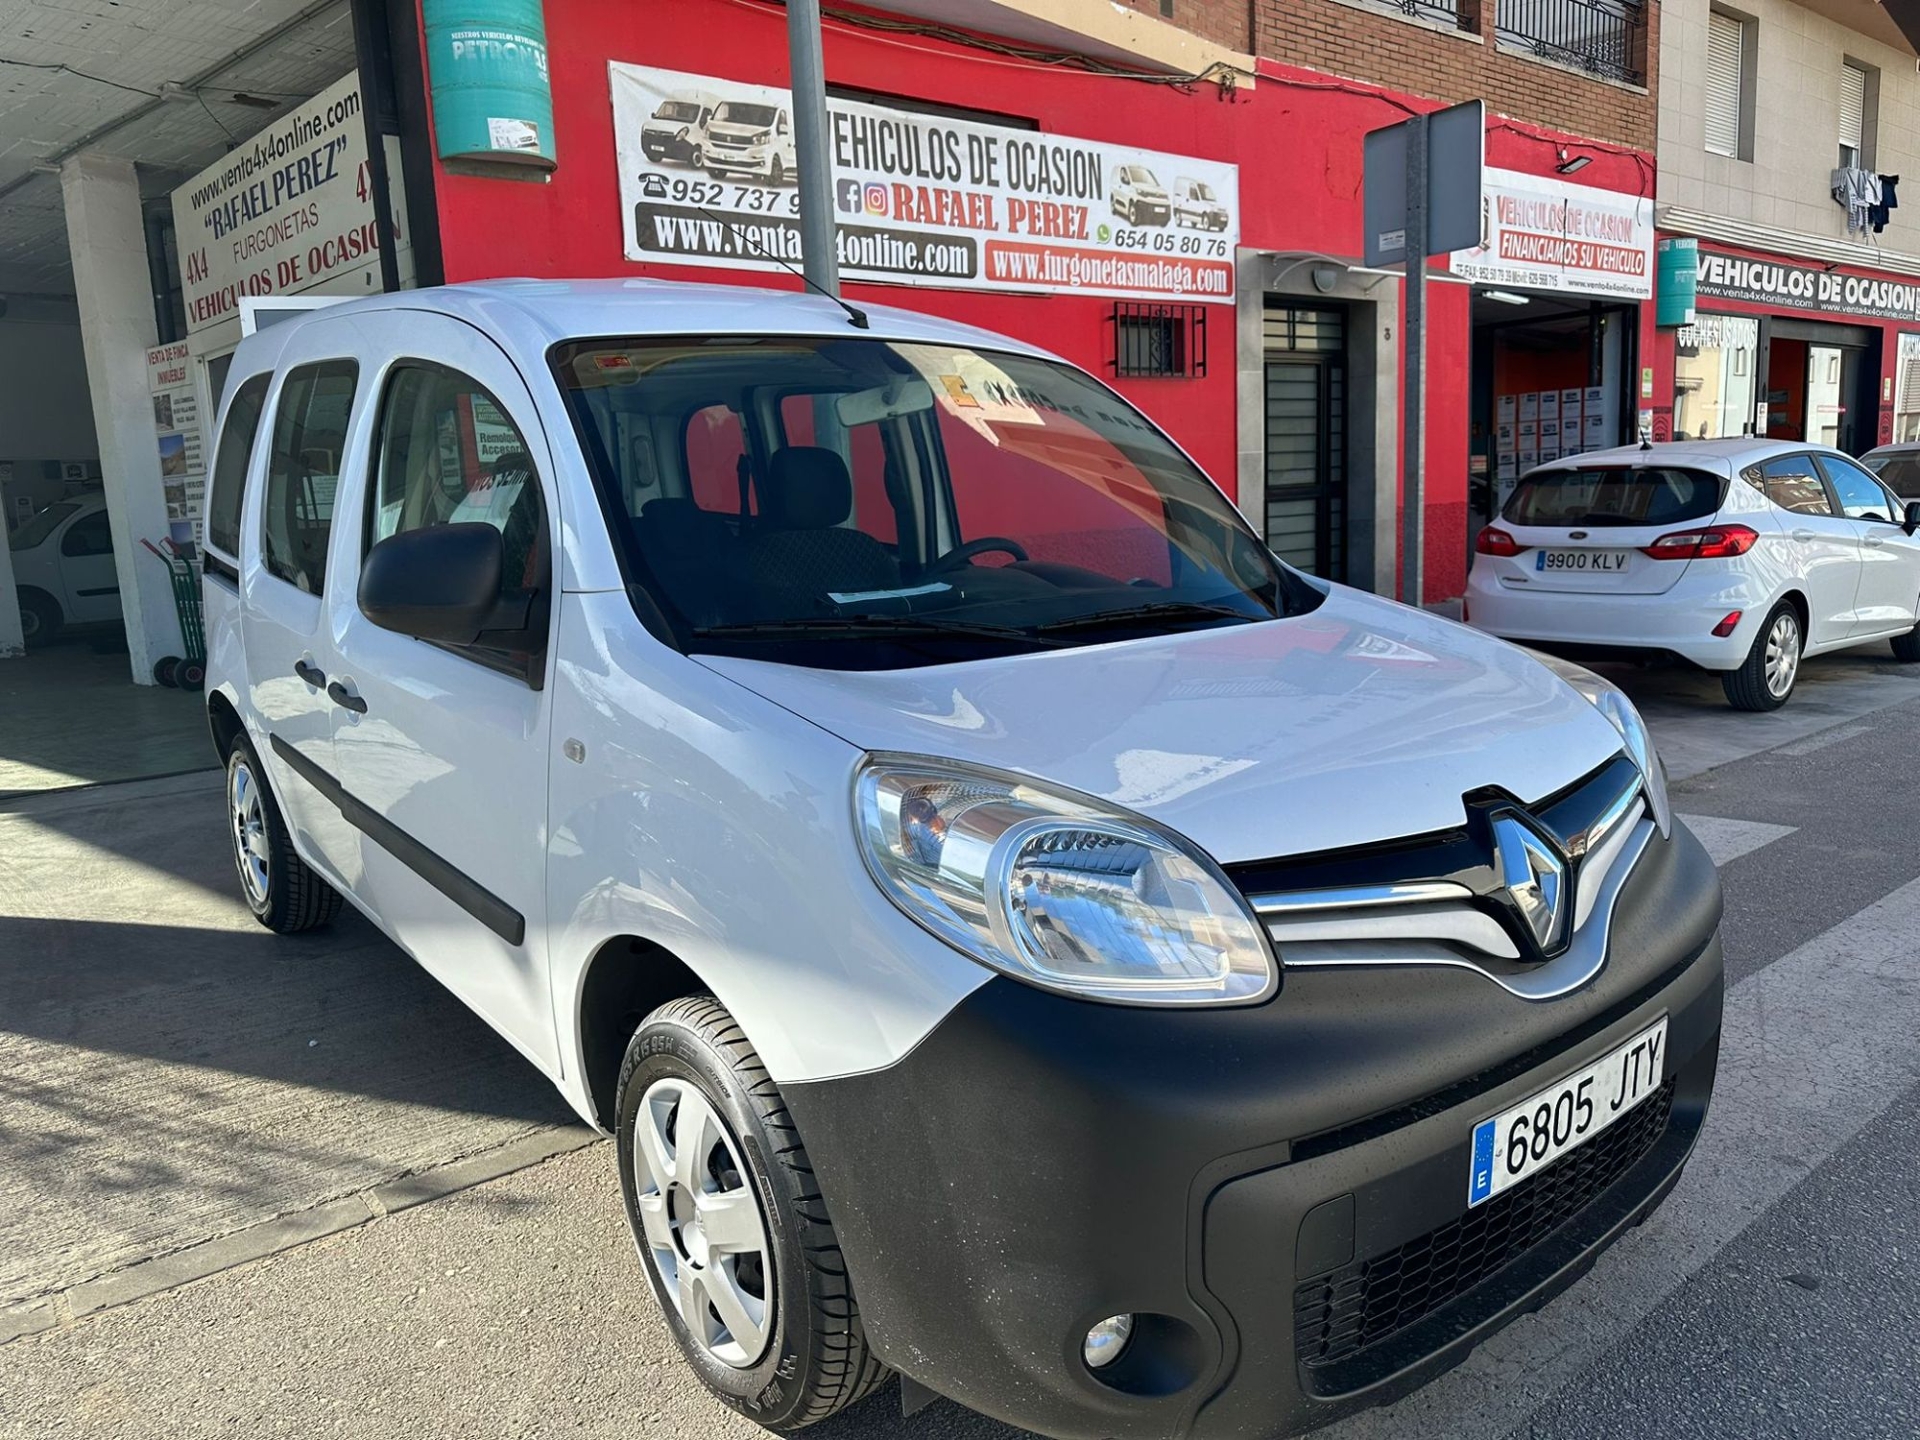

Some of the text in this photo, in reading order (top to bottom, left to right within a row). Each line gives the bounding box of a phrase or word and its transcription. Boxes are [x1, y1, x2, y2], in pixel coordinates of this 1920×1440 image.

[191, 90, 360, 210] www.venta4x4online.com
[826, 111, 1103, 201] EHICULOS DE OCASION
[672, 179, 801, 215] 952 737 9
[891, 182, 1089, 241] RAFAEL PEREZ
[1496, 194, 1633, 244] VEHICULOS DE OCASION
[232, 202, 319, 264] FURGONETAS
[653, 214, 969, 275] www.venta4online.com
[1114, 228, 1227, 257] 654 05 80 76
[1501, 233, 1644, 274] FINANCIAMOS SU VEHICULO
[186, 247, 209, 286] 4X4
[188, 268, 273, 324] VEHICULOS
[276, 255, 303, 289] DE
[993, 249, 1228, 294] www.furgonetasmalaga.com
[1696, 253, 1916, 312] VEHICULOS DE OCASION
[1820, 302, 1914, 320] www.venta4x4online.com
[480, 432, 518, 445] Remolqu
[1546, 553, 1587, 569] 9900
[1506, 1030, 1662, 1175] 6805 JTY
[1477, 1169, 1488, 1190] E
